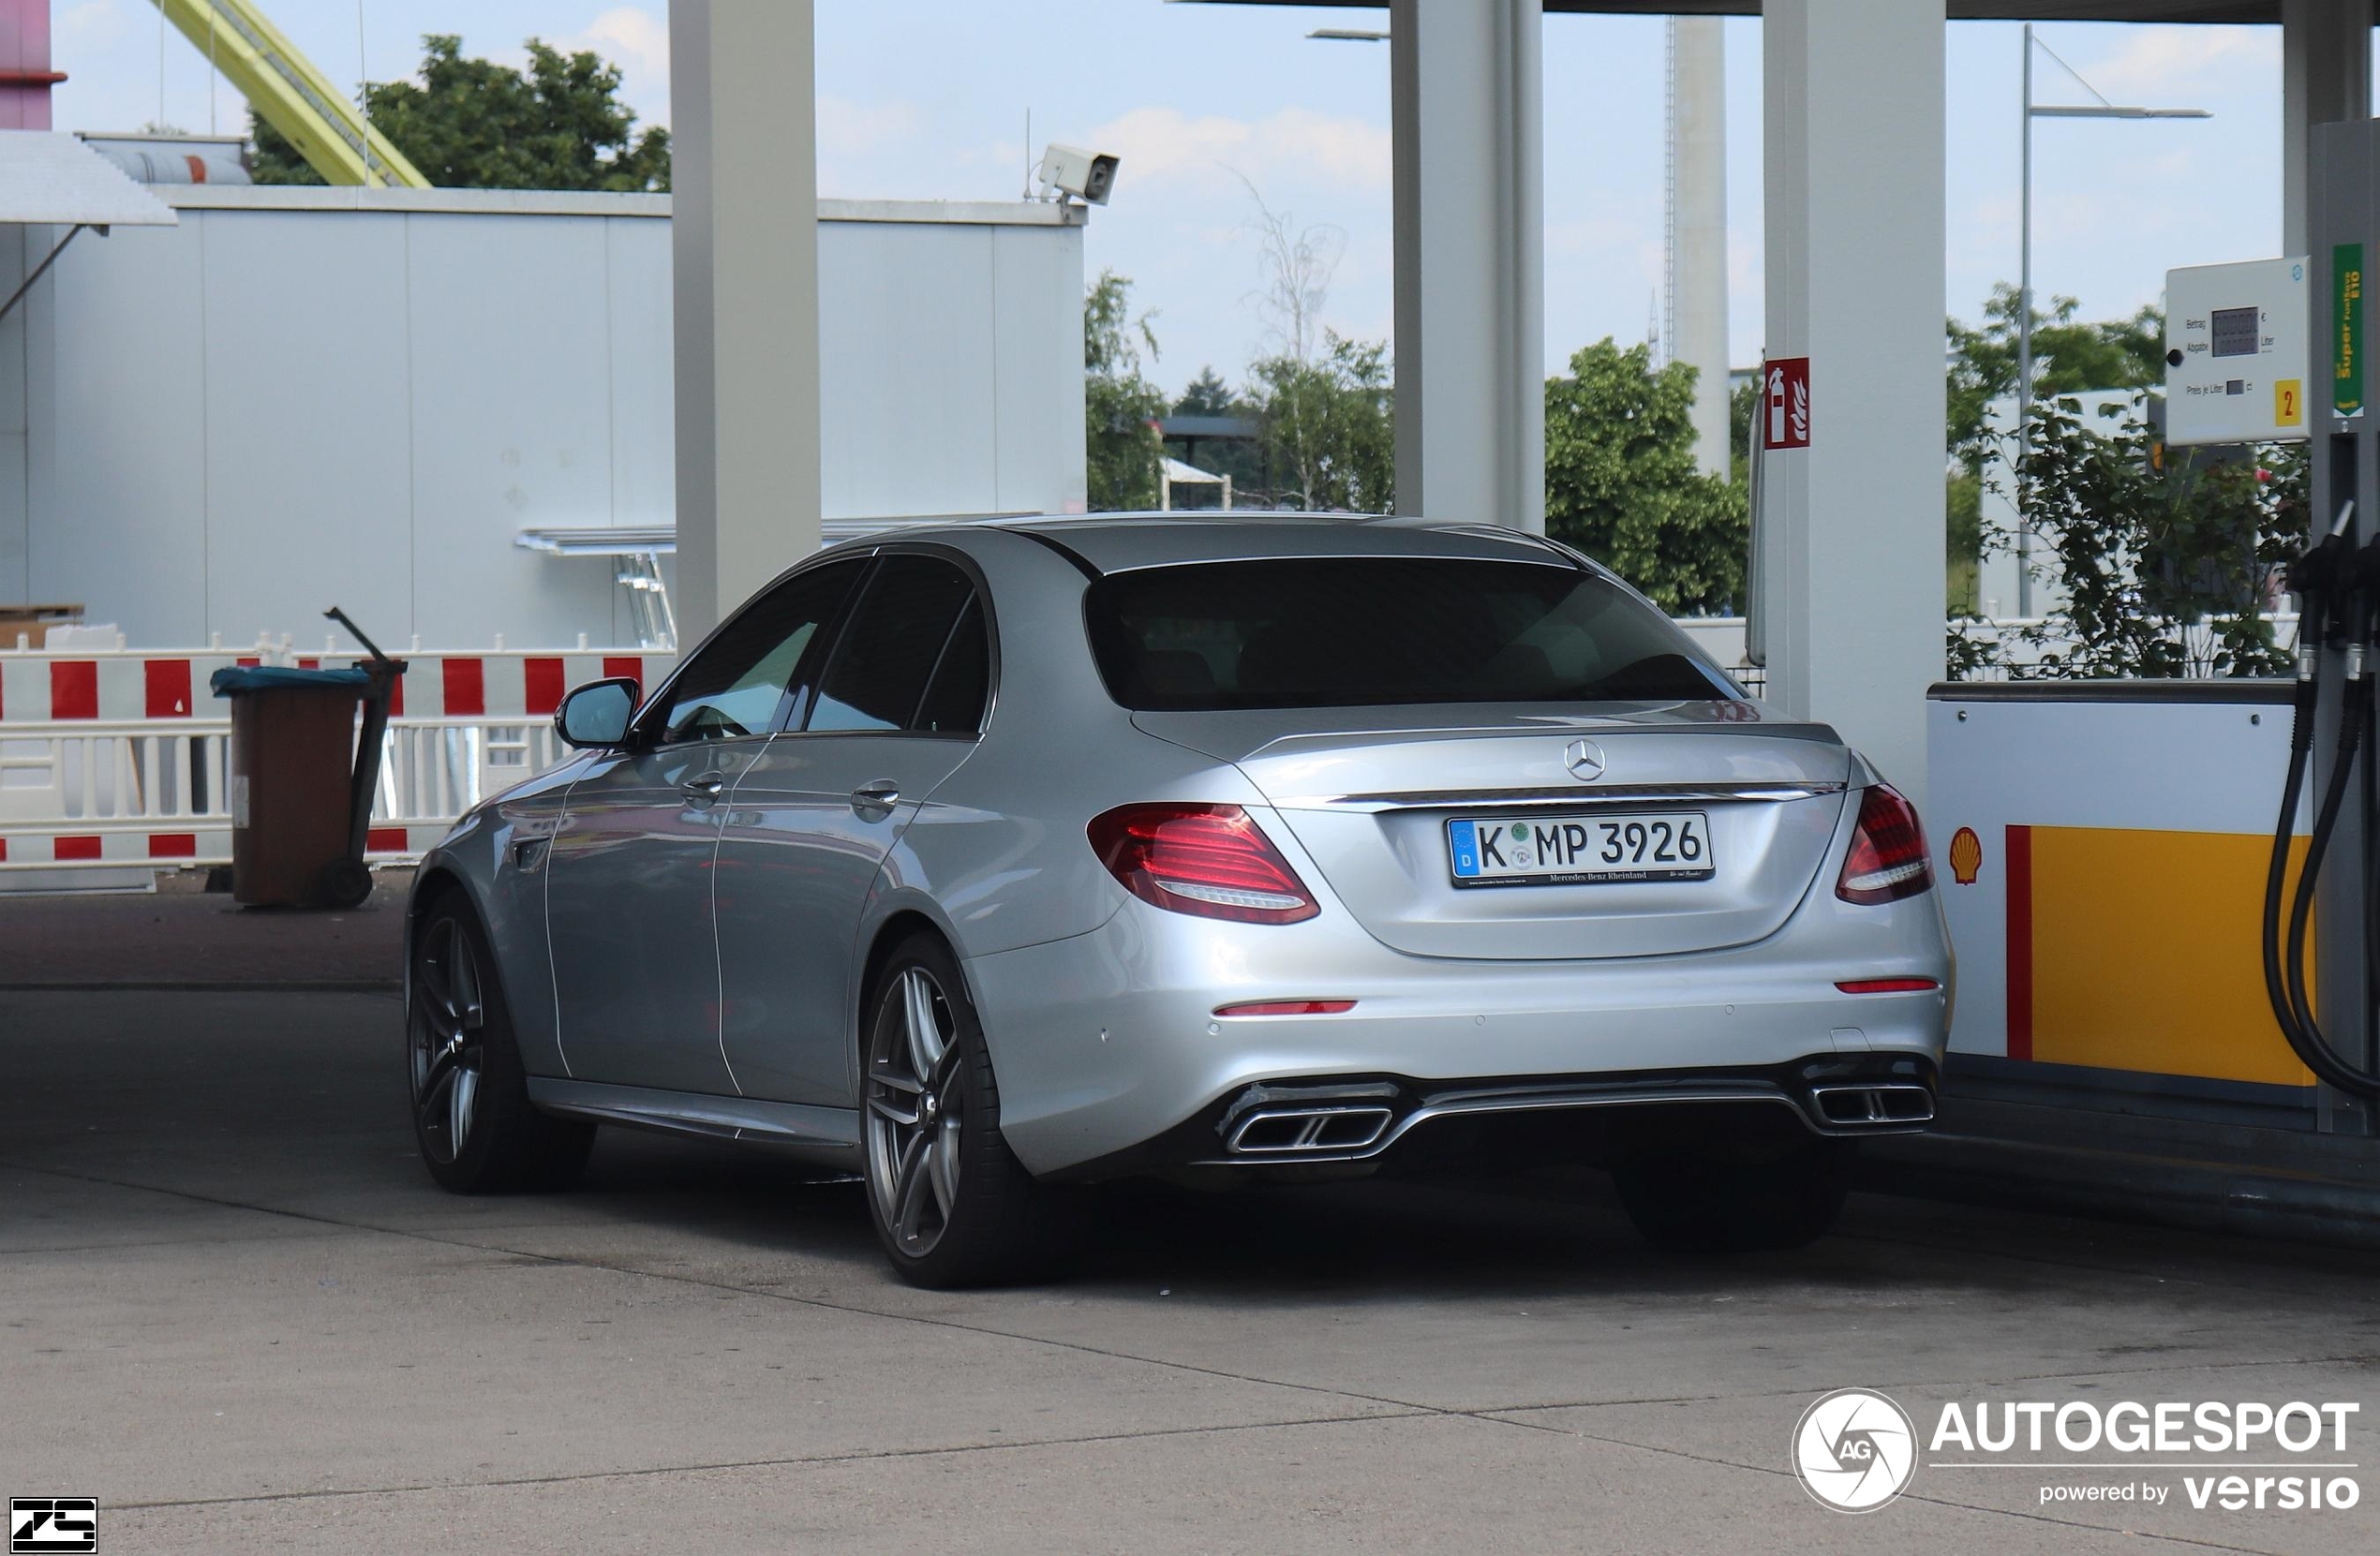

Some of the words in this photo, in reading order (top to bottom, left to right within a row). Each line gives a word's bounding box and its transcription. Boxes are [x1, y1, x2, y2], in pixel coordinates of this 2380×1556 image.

[2350, 270, 2360, 299] E10
[2261, 312, 2267, 322] €
[2186, 319, 2206, 331] Betrag
[2261, 336, 2274, 347] Liter
[2187, 342, 2209, 354] Abgabe
[2341, 323, 2354, 378] Super
[2186, 385, 2202, 395] Preis
[2209, 383, 2224, 394] Liter
[2284, 391, 2293, 416] 2
[1479, 826, 1508, 868] K
[1534, 824, 1589, 867] MP
[1599, 821, 1702, 864] 3926
[1462, 854, 1471, 867] D
[1608, 871, 1647, 881] Rheinland
